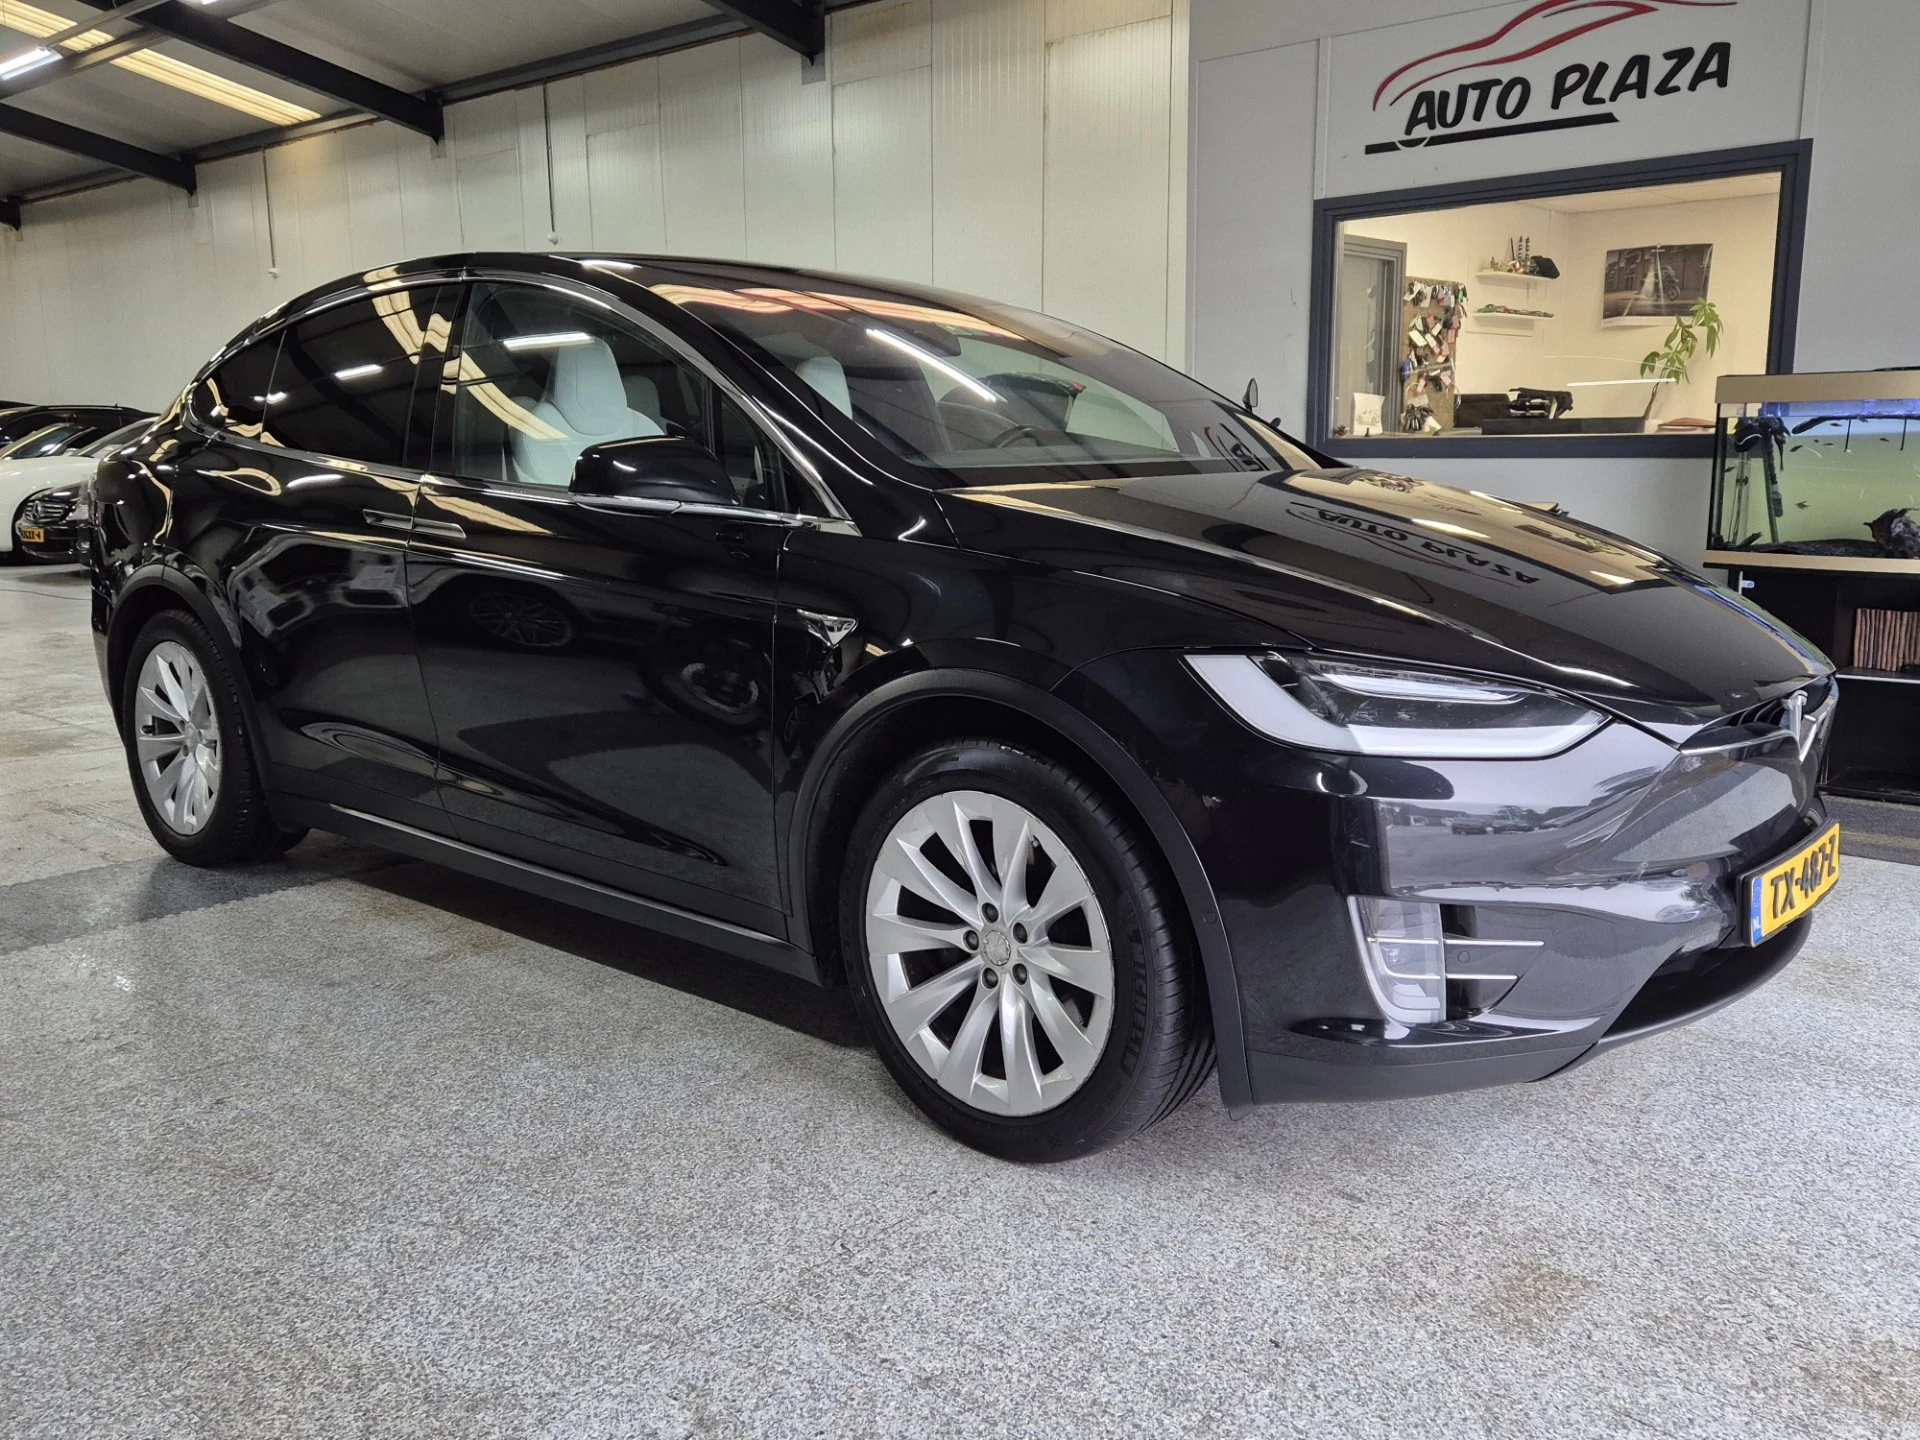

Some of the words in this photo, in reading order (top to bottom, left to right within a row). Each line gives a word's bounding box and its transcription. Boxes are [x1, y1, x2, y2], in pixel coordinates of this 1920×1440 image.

[1404, 76, 1531, 136] AUTO
[1551, 42, 1732, 110] PLAZA
[1770, 834, 1837, 920] TX-487-Z
[1753, 915, 1761, 932] NL
[1122, 941, 1148, 1075] MICHELIN
